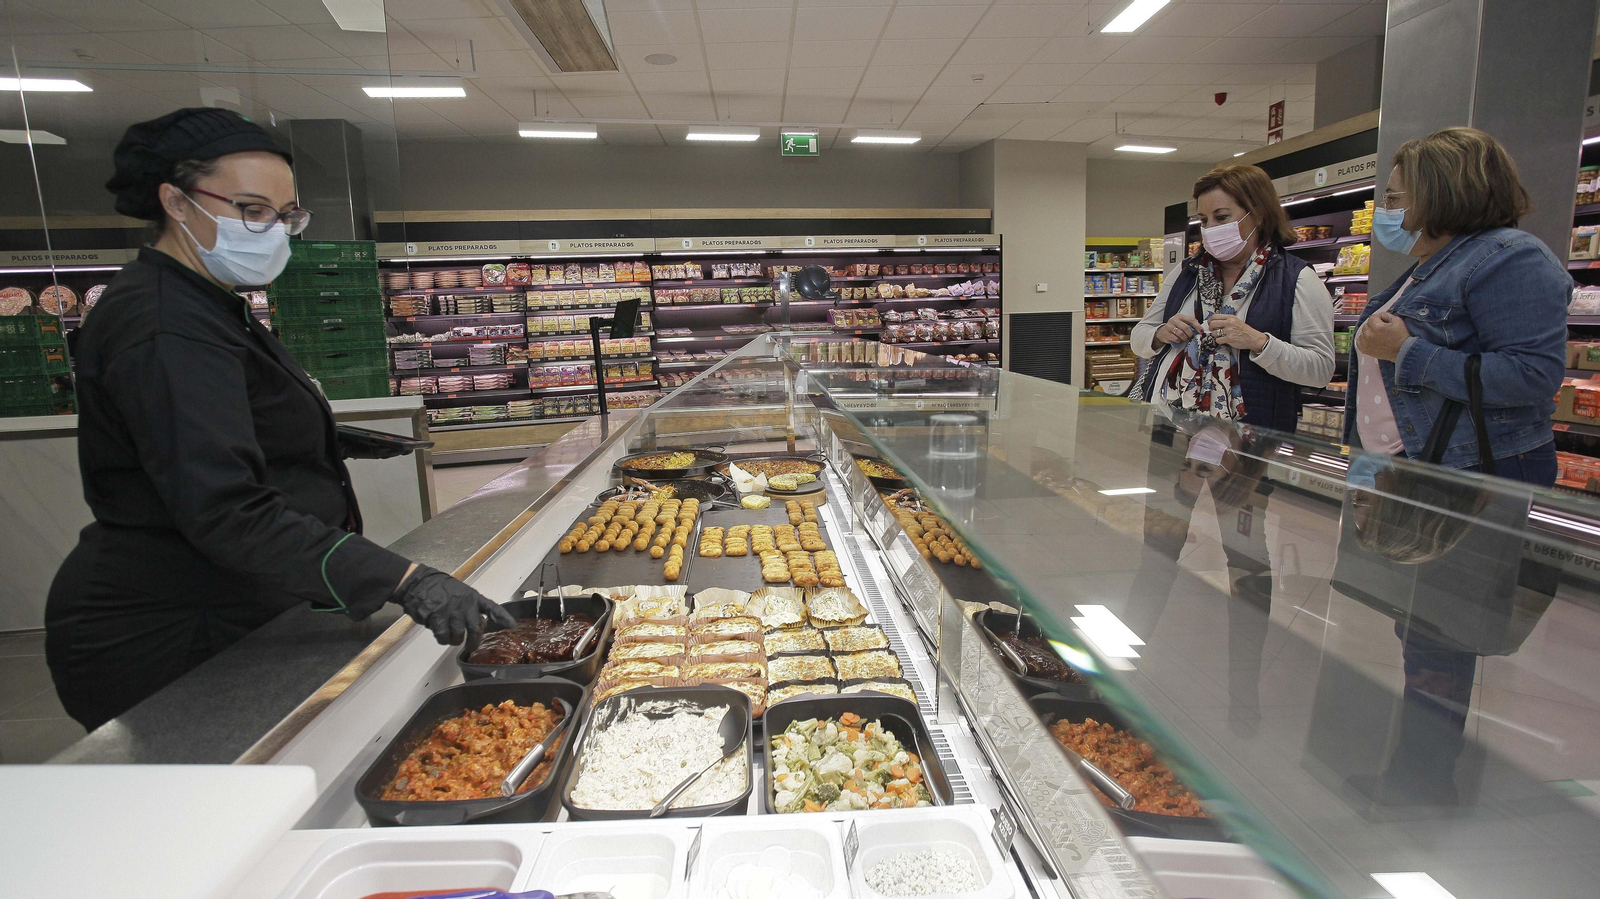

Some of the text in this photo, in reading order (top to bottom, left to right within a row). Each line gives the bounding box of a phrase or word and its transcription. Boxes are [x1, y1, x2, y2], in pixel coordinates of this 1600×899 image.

[1337, 160, 1376, 176] PLATOS PR
[1579, 292, 1596, 300] Tofu
[1576, 408, 1595, 418] MMUS
[1000, 811, 1013, 836] QUESO
